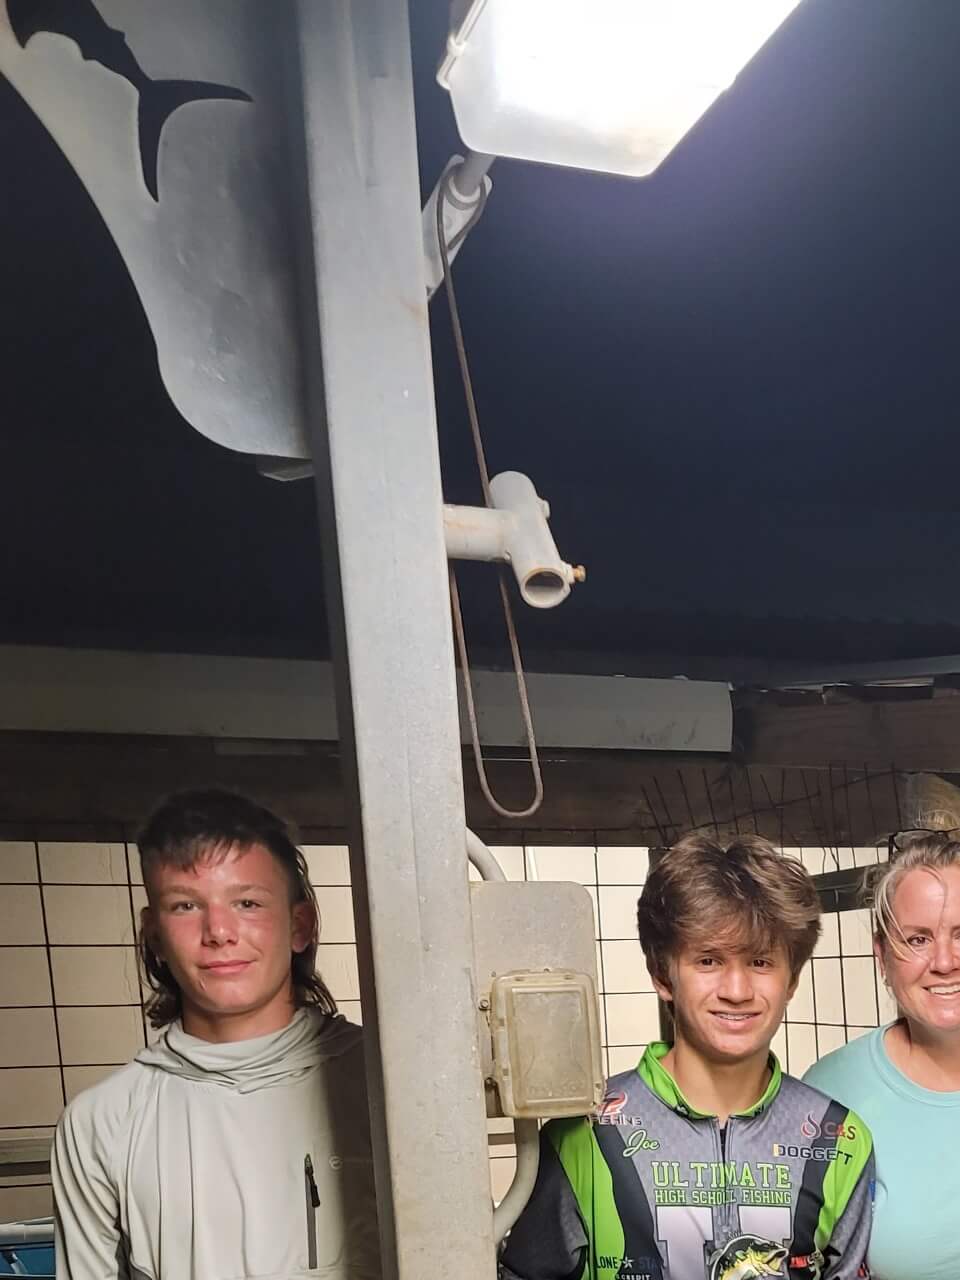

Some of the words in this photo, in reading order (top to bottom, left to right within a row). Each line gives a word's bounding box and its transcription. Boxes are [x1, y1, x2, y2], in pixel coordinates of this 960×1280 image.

[823, 1120, 857, 1141] C&S
[622, 1129, 660, 1158] Joe
[773, 1143, 853, 1165] DOGGETT
[651, 1160, 793, 1190] ULTIMATE
[654, 1188, 687, 1204] HIGH
[742, 1189, 792, 1205] FISHING
